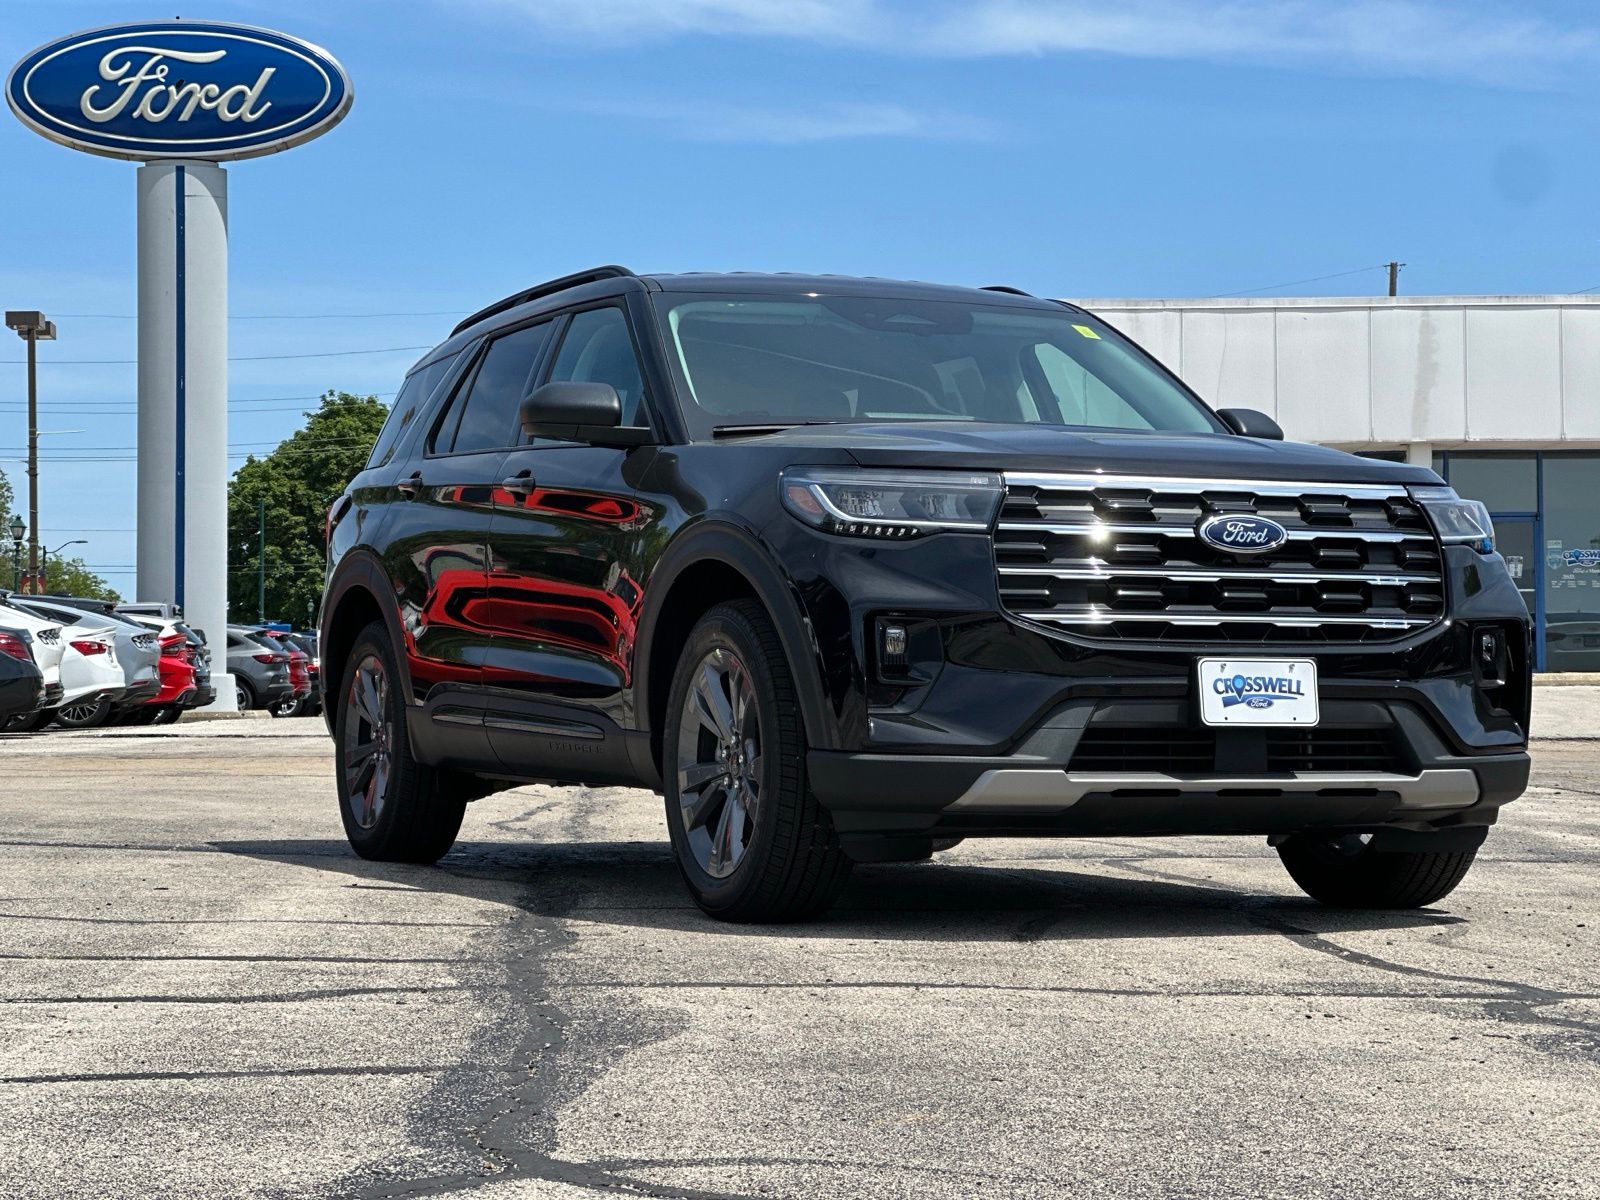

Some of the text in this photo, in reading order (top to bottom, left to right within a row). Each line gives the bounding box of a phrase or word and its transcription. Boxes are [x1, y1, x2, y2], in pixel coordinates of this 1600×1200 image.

[80, 46, 277, 122] Ford
[1223, 521, 1268, 543] Ford
[1213, 675, 1305, 697] CROSSWELL
[1250, 697, 1269, 708] Ford
